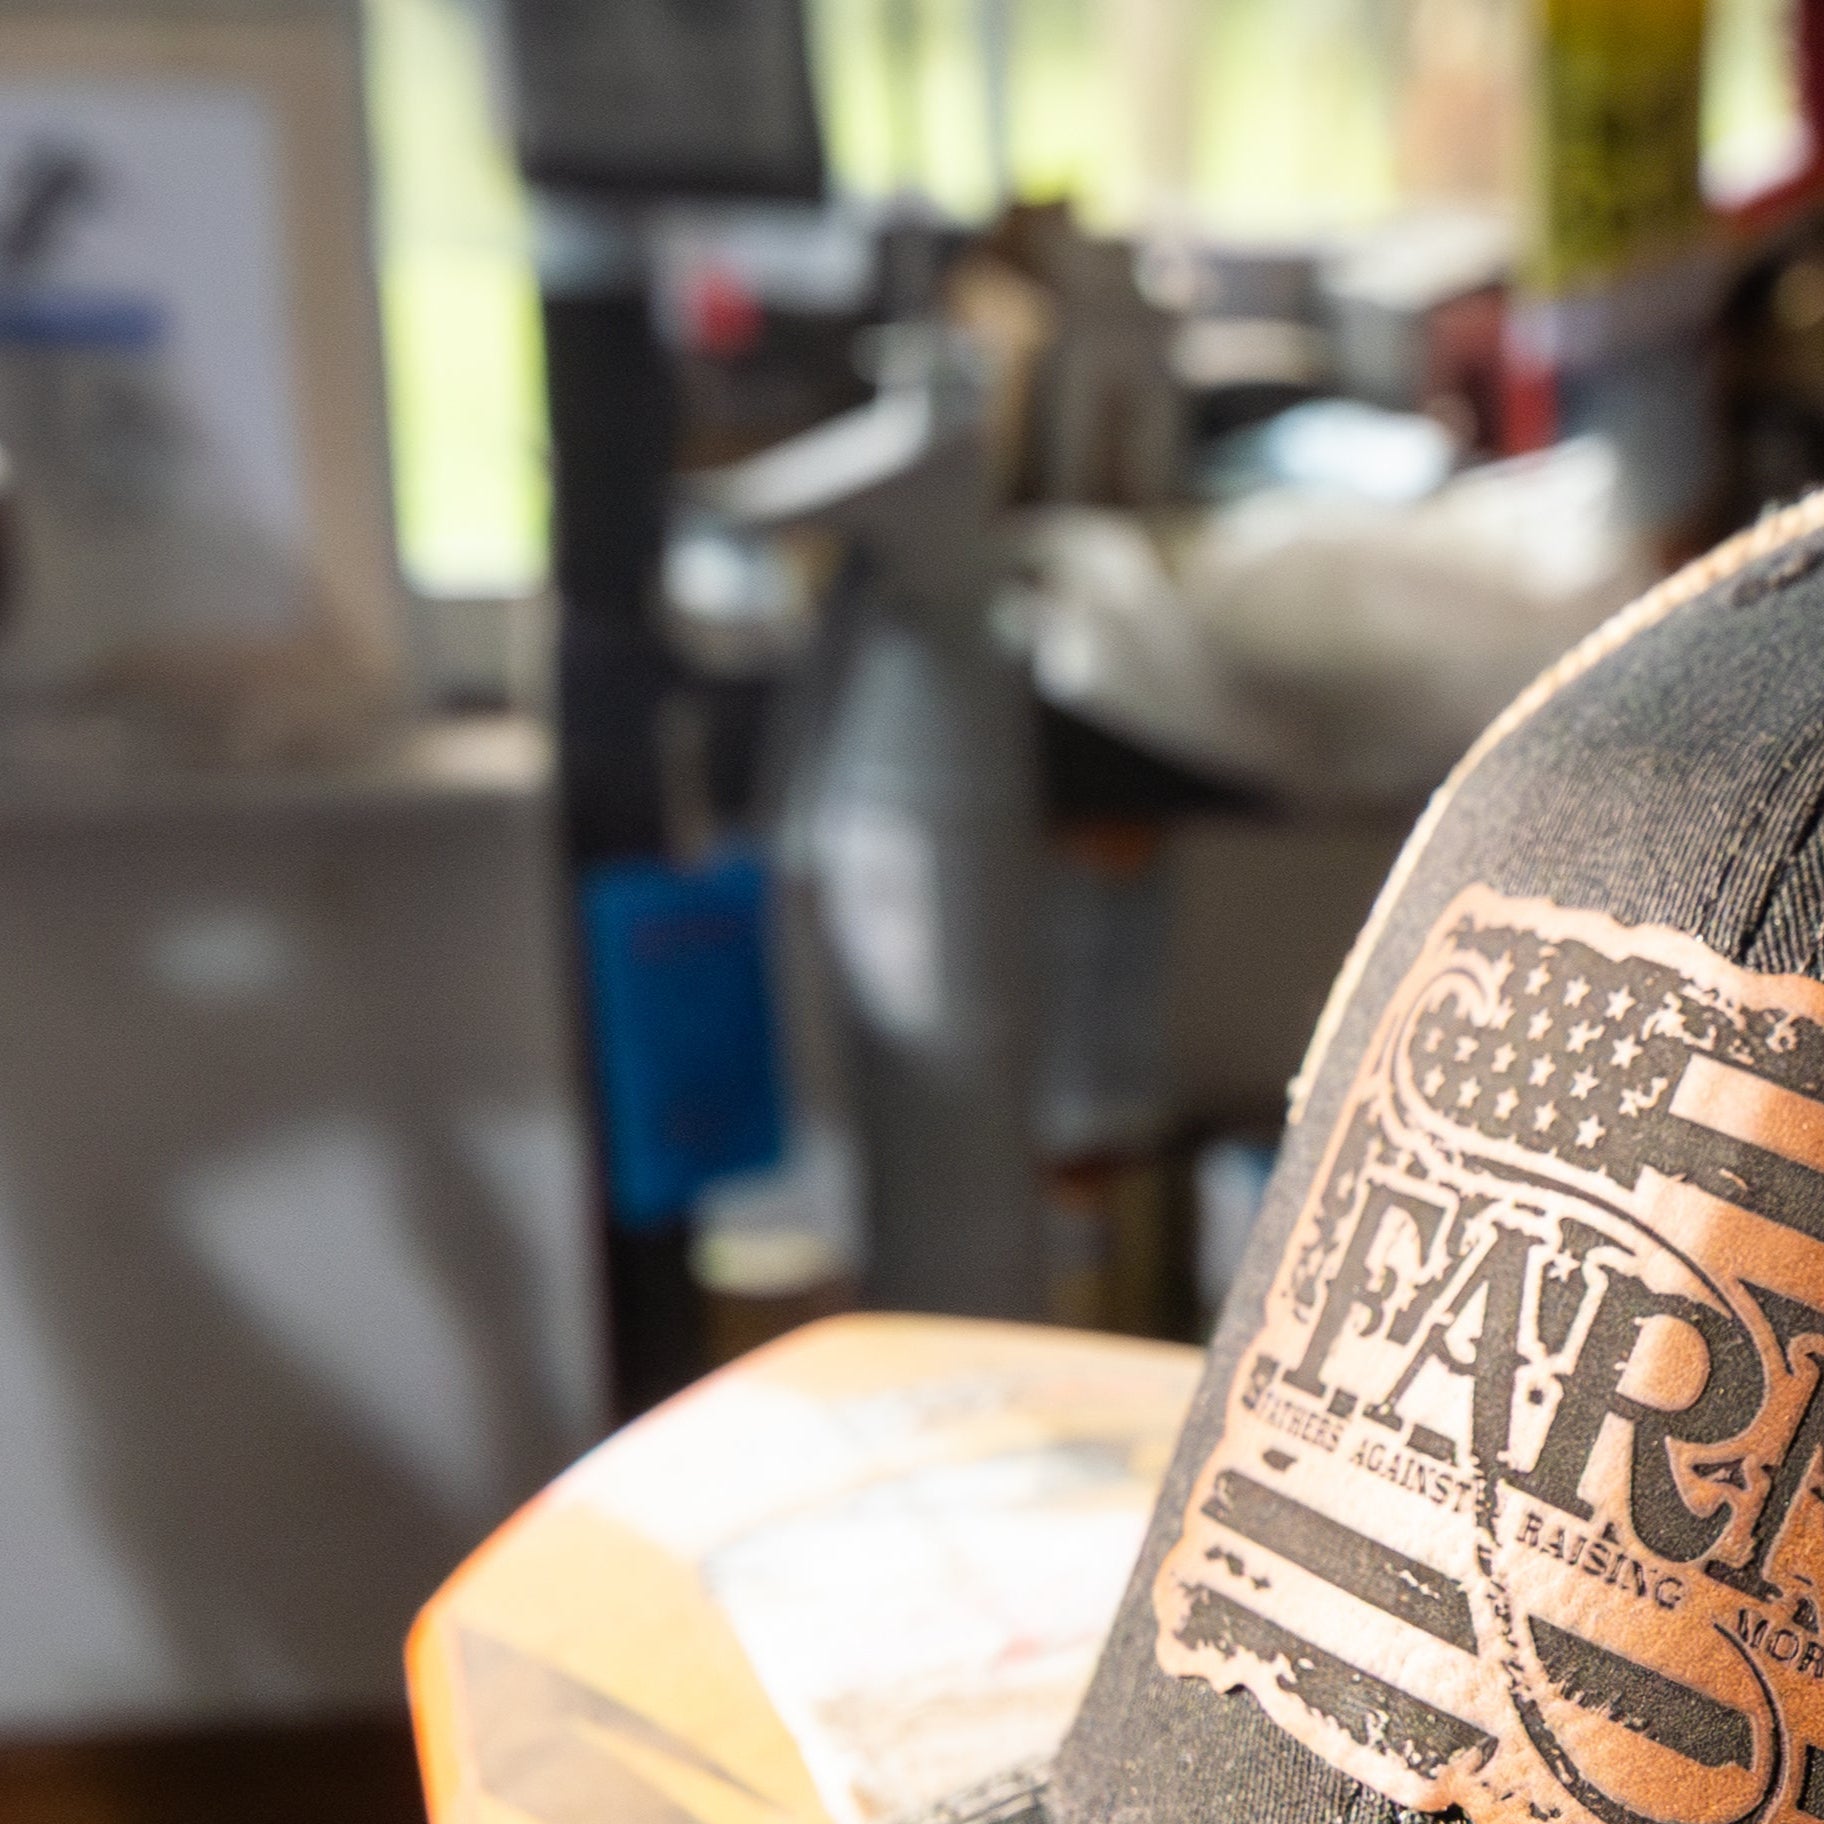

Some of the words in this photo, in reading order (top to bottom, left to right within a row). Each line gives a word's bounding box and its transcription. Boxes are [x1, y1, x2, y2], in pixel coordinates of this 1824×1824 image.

[1254, 1388, 1345, 1453] FATHERS
[1349, 1436, 1474, 1513] AGAINST
[1515, 1511, 1687, 1611] RAISING
